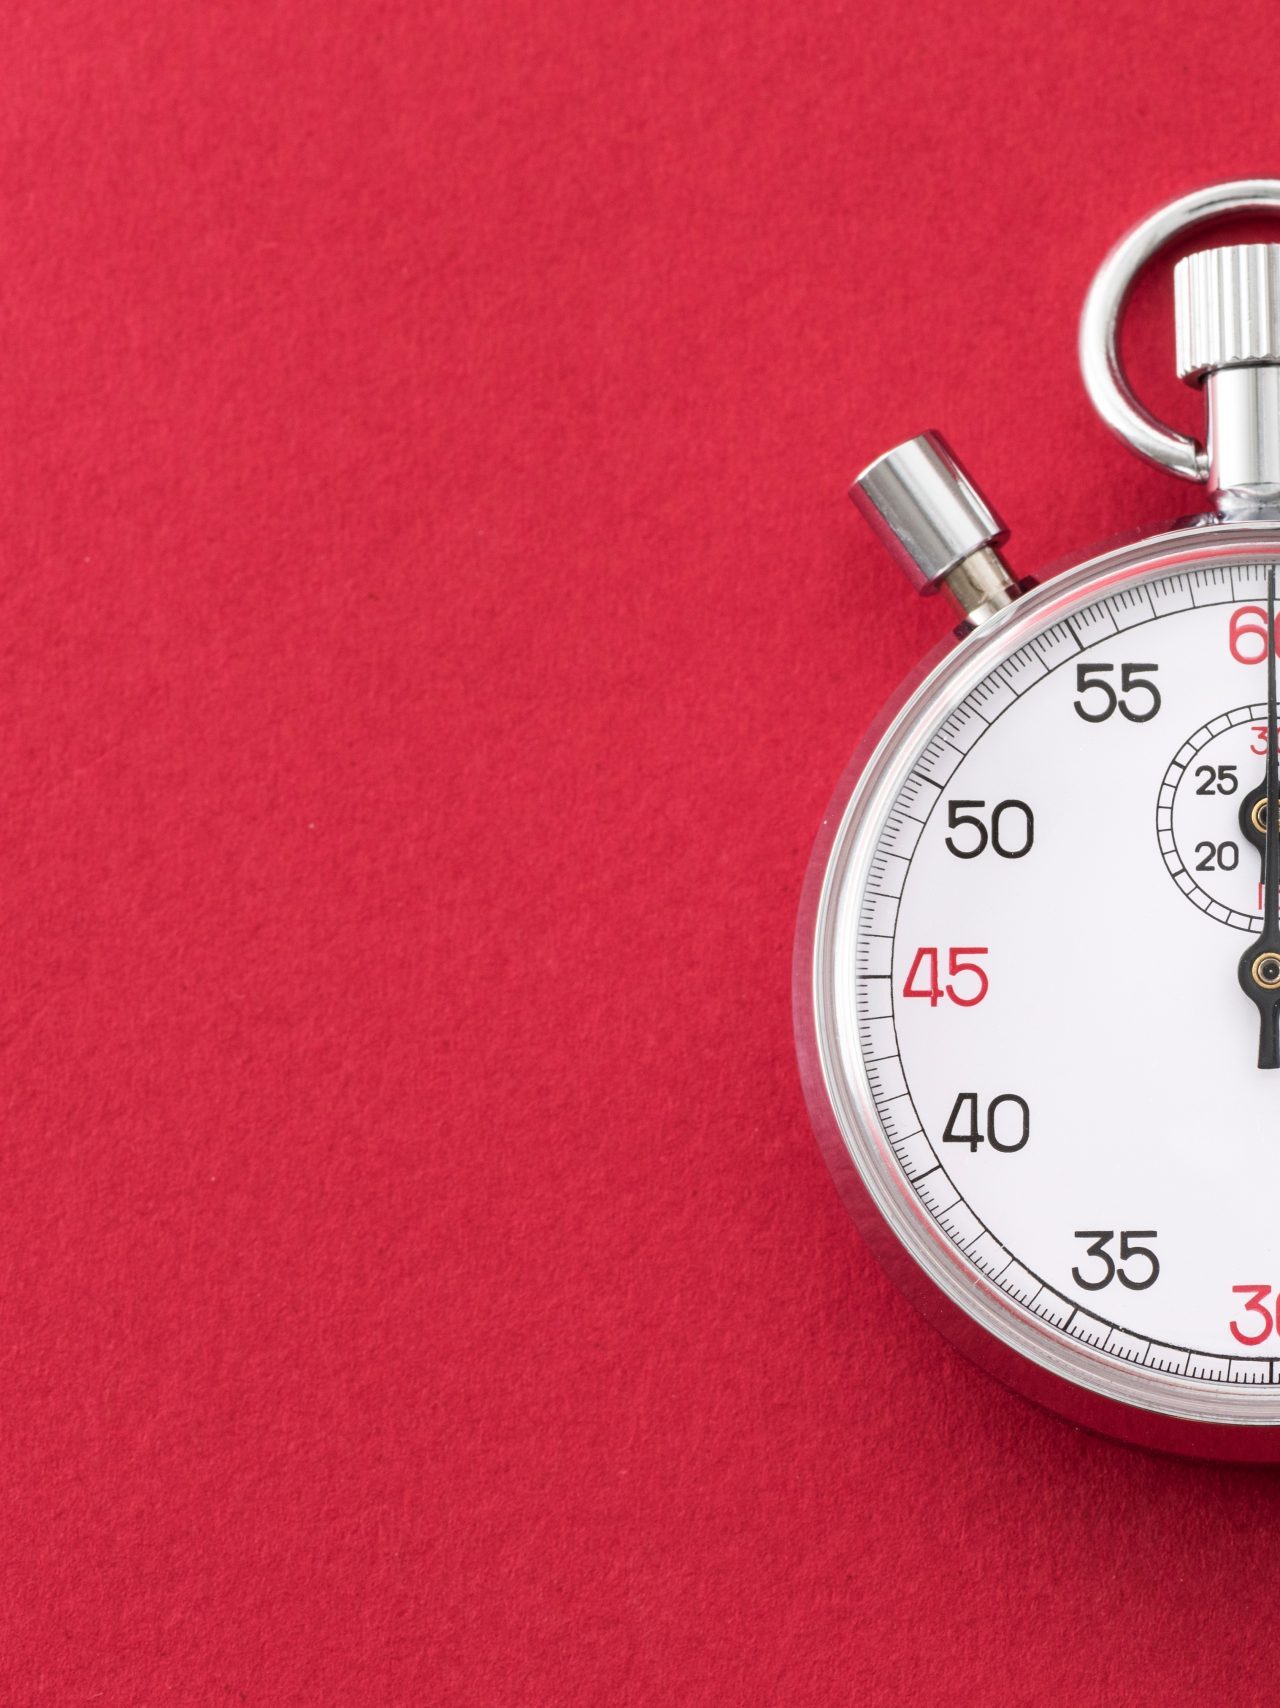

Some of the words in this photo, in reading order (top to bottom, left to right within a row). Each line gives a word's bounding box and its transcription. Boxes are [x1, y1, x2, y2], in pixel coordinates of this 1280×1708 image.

[1074, 663, 1161, 723] 55
[1194, 764, 1239, 796] 25
[945, 800, 1035, 860] 50
[1194, 840, 1240, 872] 20
[902, 946, 989, 1008] 45
[942, 1092, 1030, 1154] 40
[1071, 1230, 1160, 1291] 35
